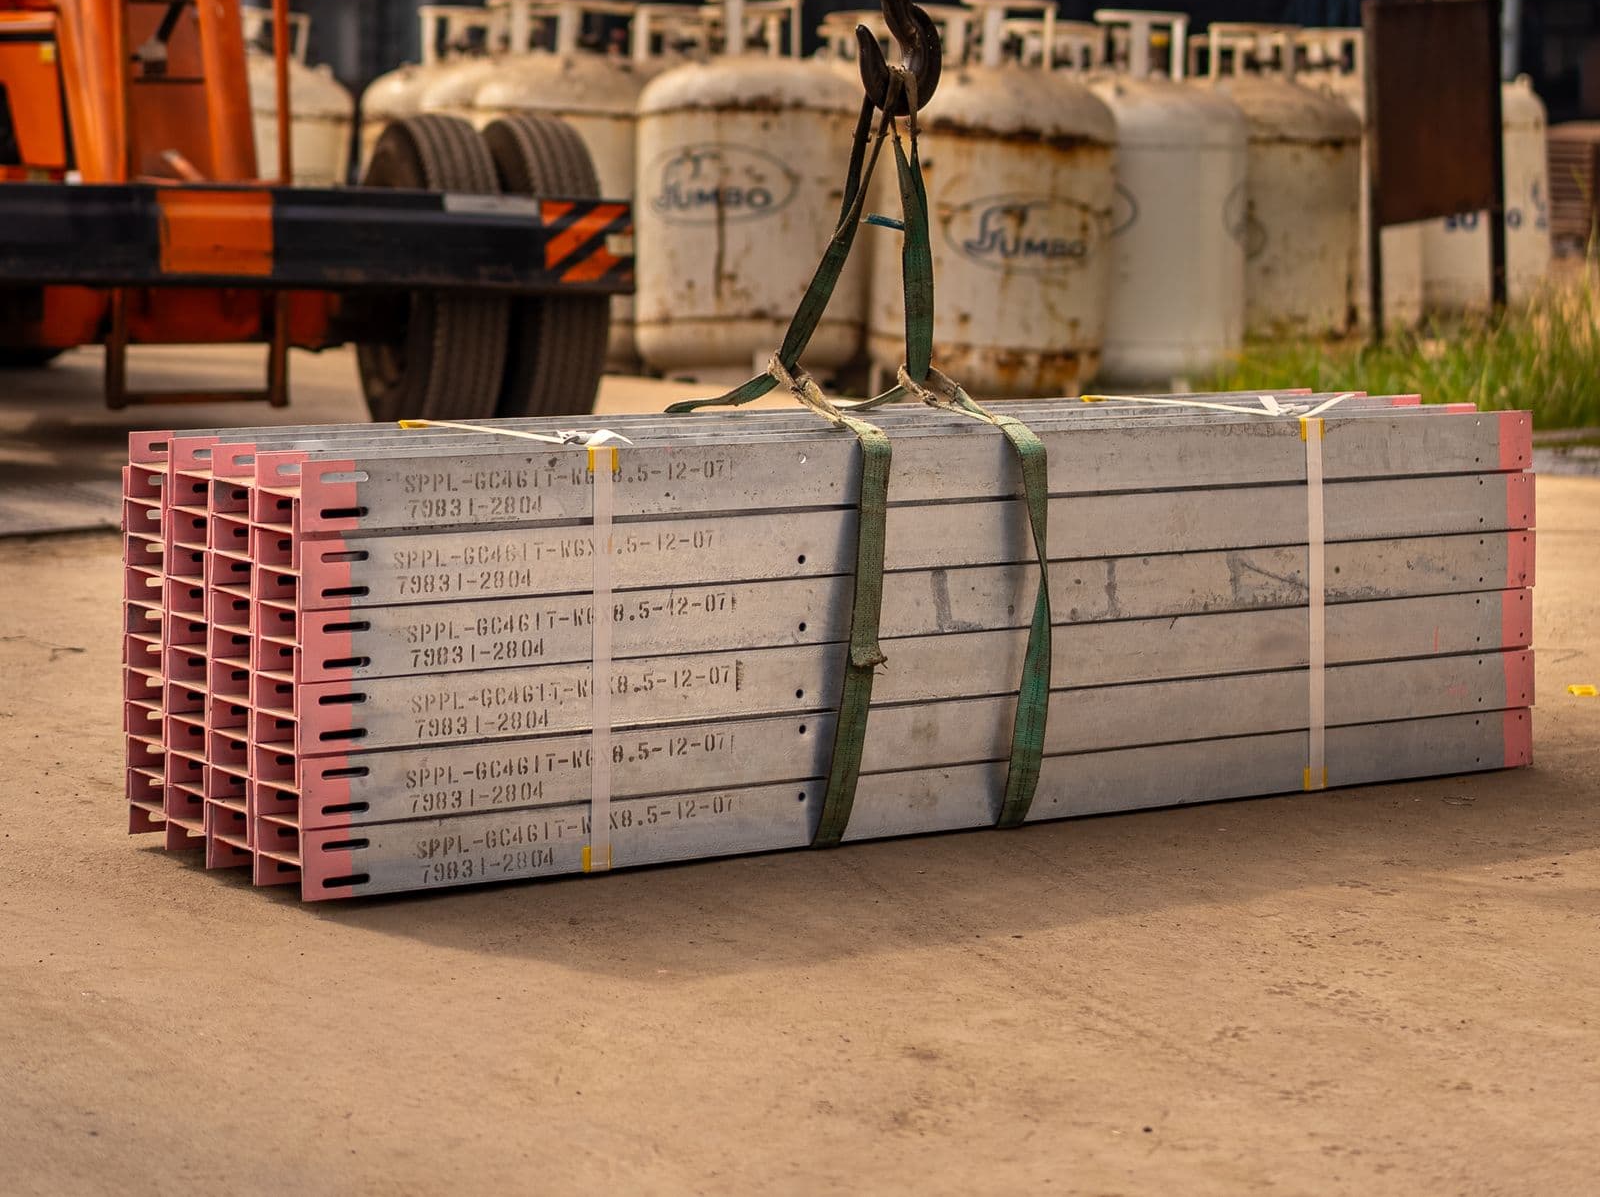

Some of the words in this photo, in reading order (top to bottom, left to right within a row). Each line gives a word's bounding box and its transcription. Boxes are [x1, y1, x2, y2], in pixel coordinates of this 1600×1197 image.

[408, 495, 543, 519] 79831-2804
[399, 569, 532, 595] 79831-2804
[410, 637, 544, 666] 79831-2804
[414, 708, 549, 740] 79831-2804
[409, 780, 544, 814] 79831-2804
[421, 846, 554, 884] 79831-2804
